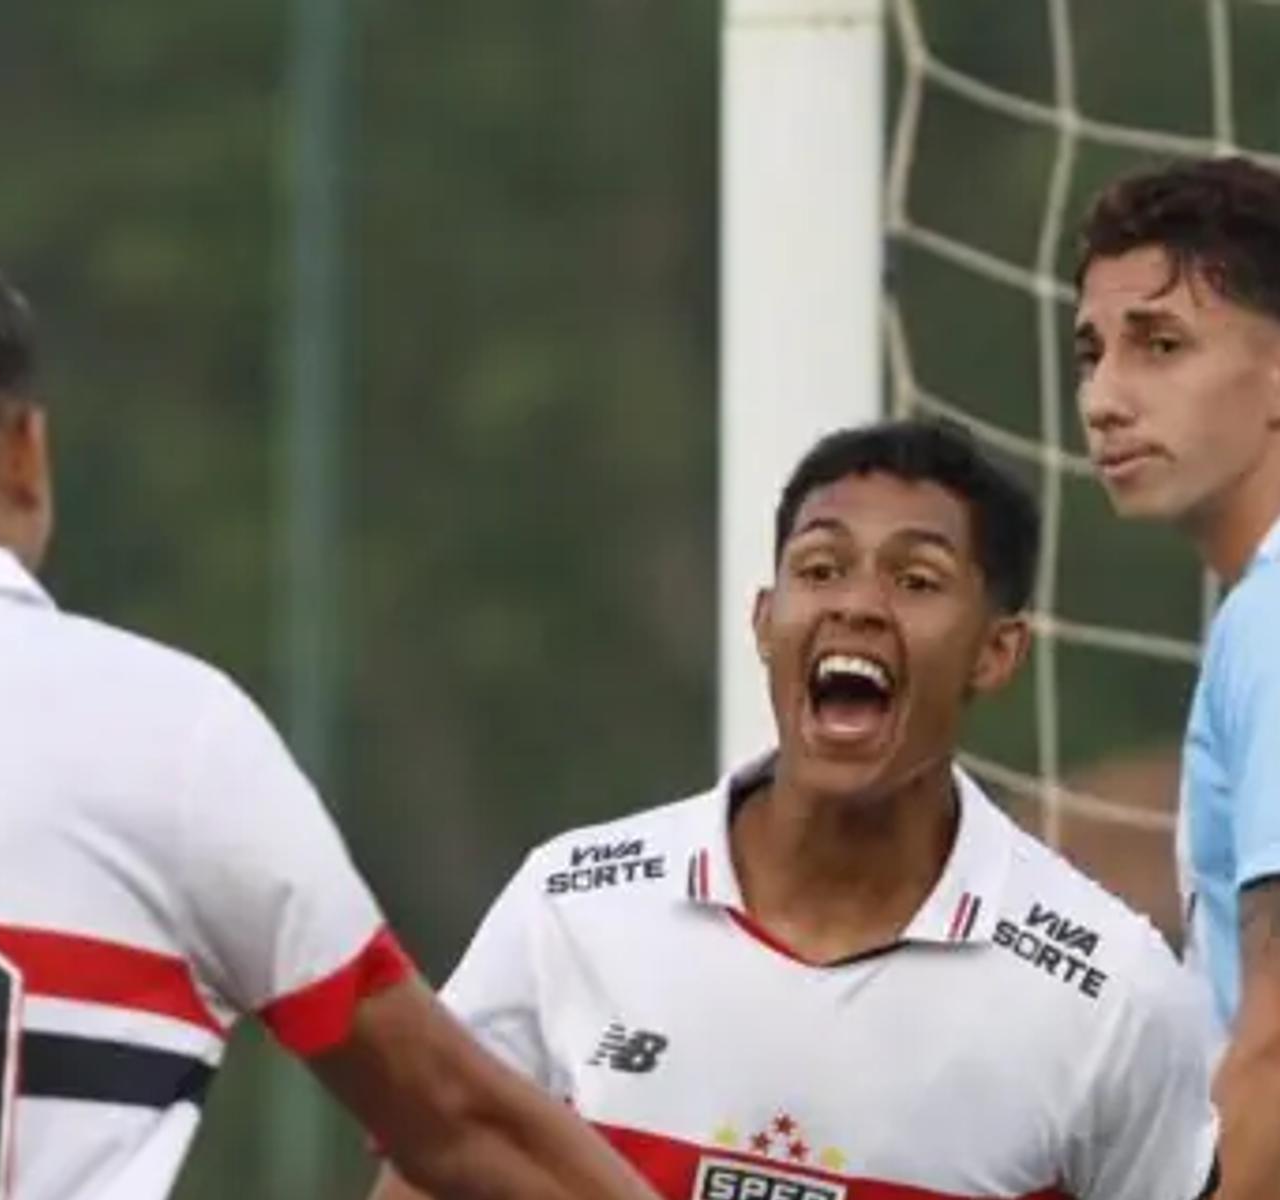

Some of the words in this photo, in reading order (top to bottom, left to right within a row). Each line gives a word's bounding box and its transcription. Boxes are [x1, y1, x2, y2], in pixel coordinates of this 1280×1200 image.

[546, 855, 665, 894] SORTE
[571, 839, 644, 867] VIVA
[1025, 901, 1100, 957] VIVA
[991, 919, 1108, 999] SORTE
